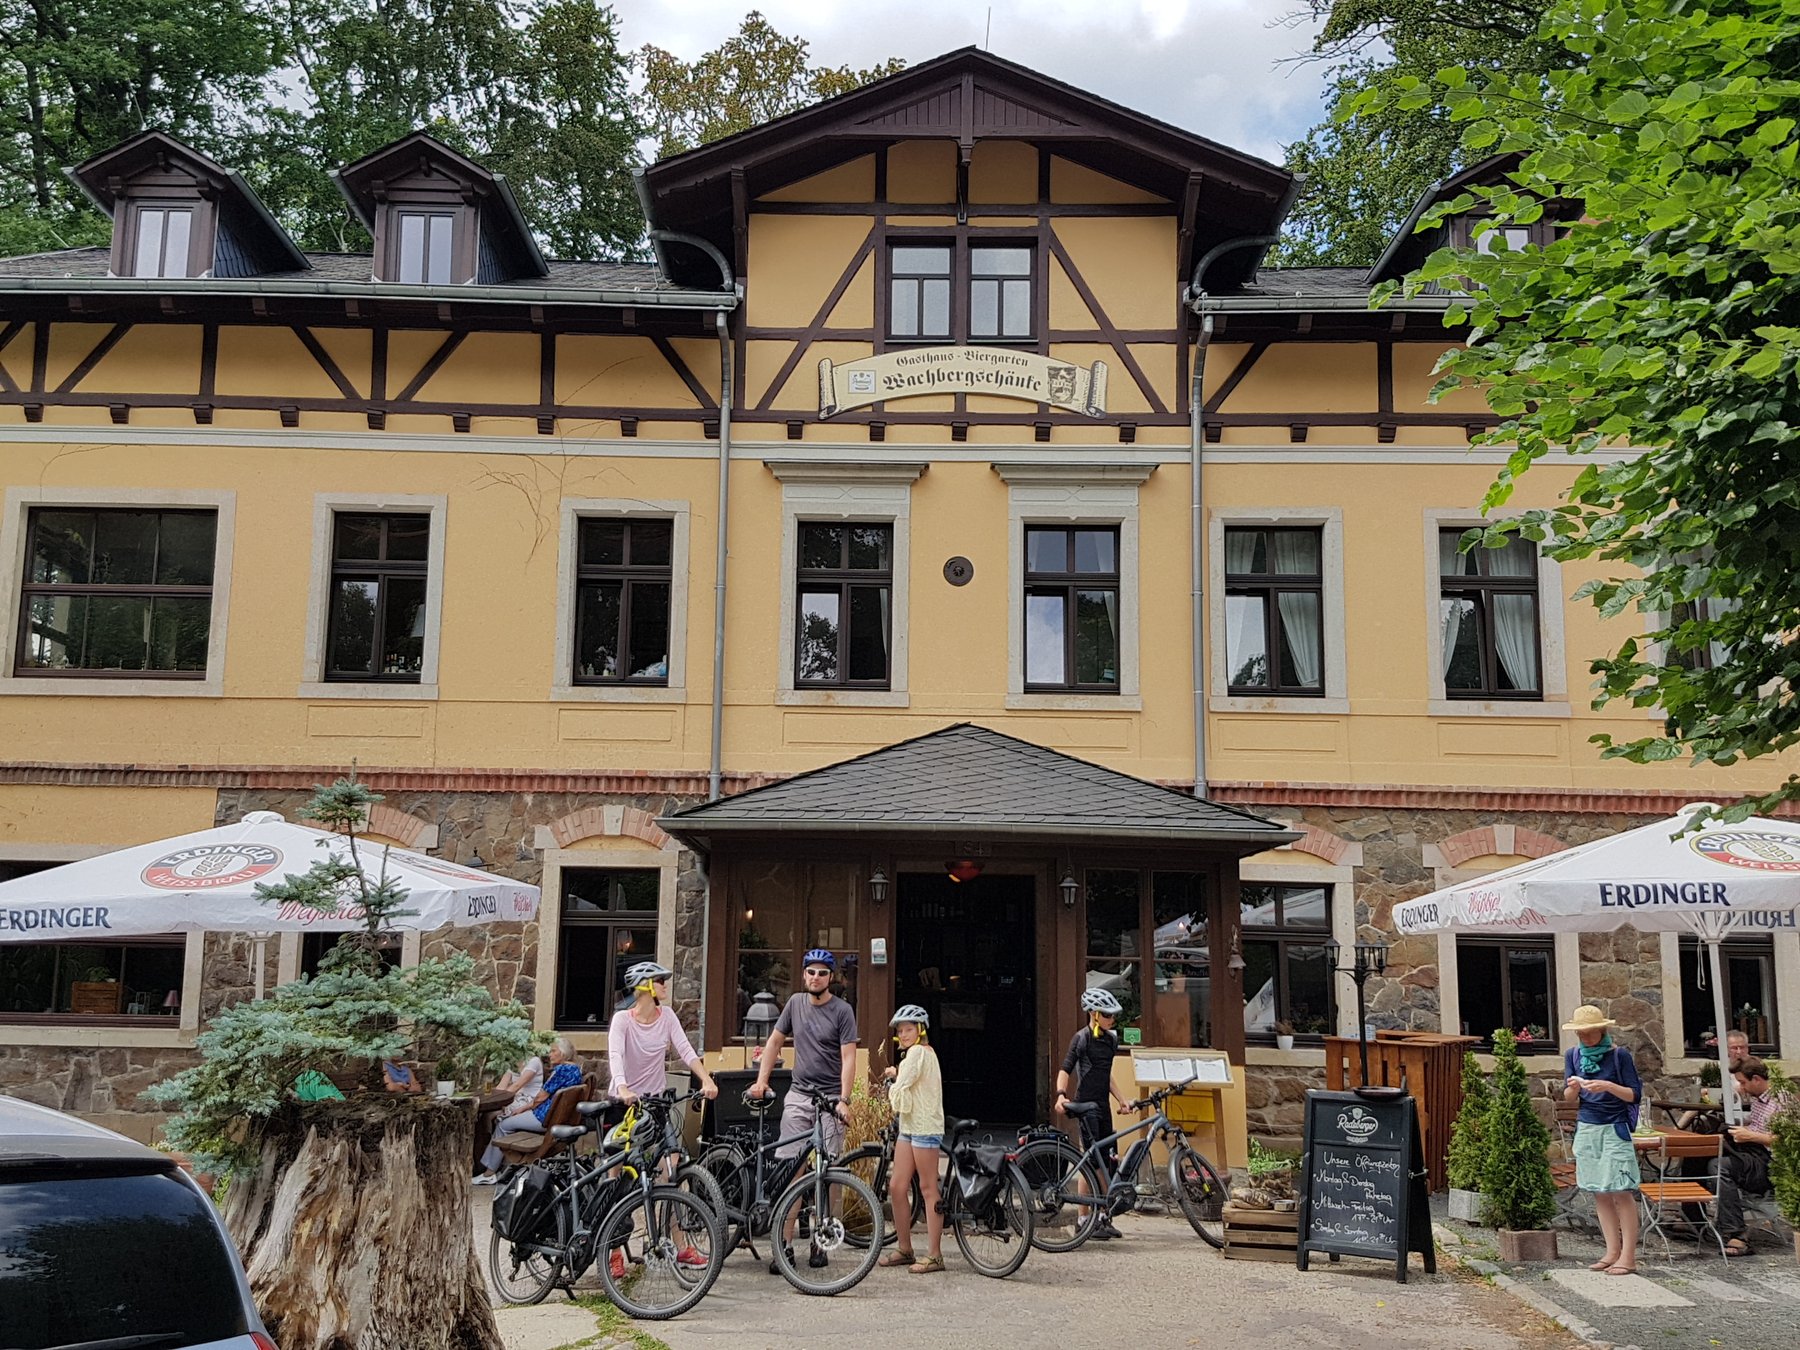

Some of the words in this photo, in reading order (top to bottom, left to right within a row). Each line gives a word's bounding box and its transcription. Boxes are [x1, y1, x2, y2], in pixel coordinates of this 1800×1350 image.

[896, 352, 954, 367] Gasthaus
[964, 350, 1029, 367] Biergarten
[882, 367, 1042, 392] Wachbergschänke
[161, 844, 275, 865] ERDINGER
[1598, 881, 1731, 908] ERDINGER
[0, 907, 112, 932] ERDINGER
